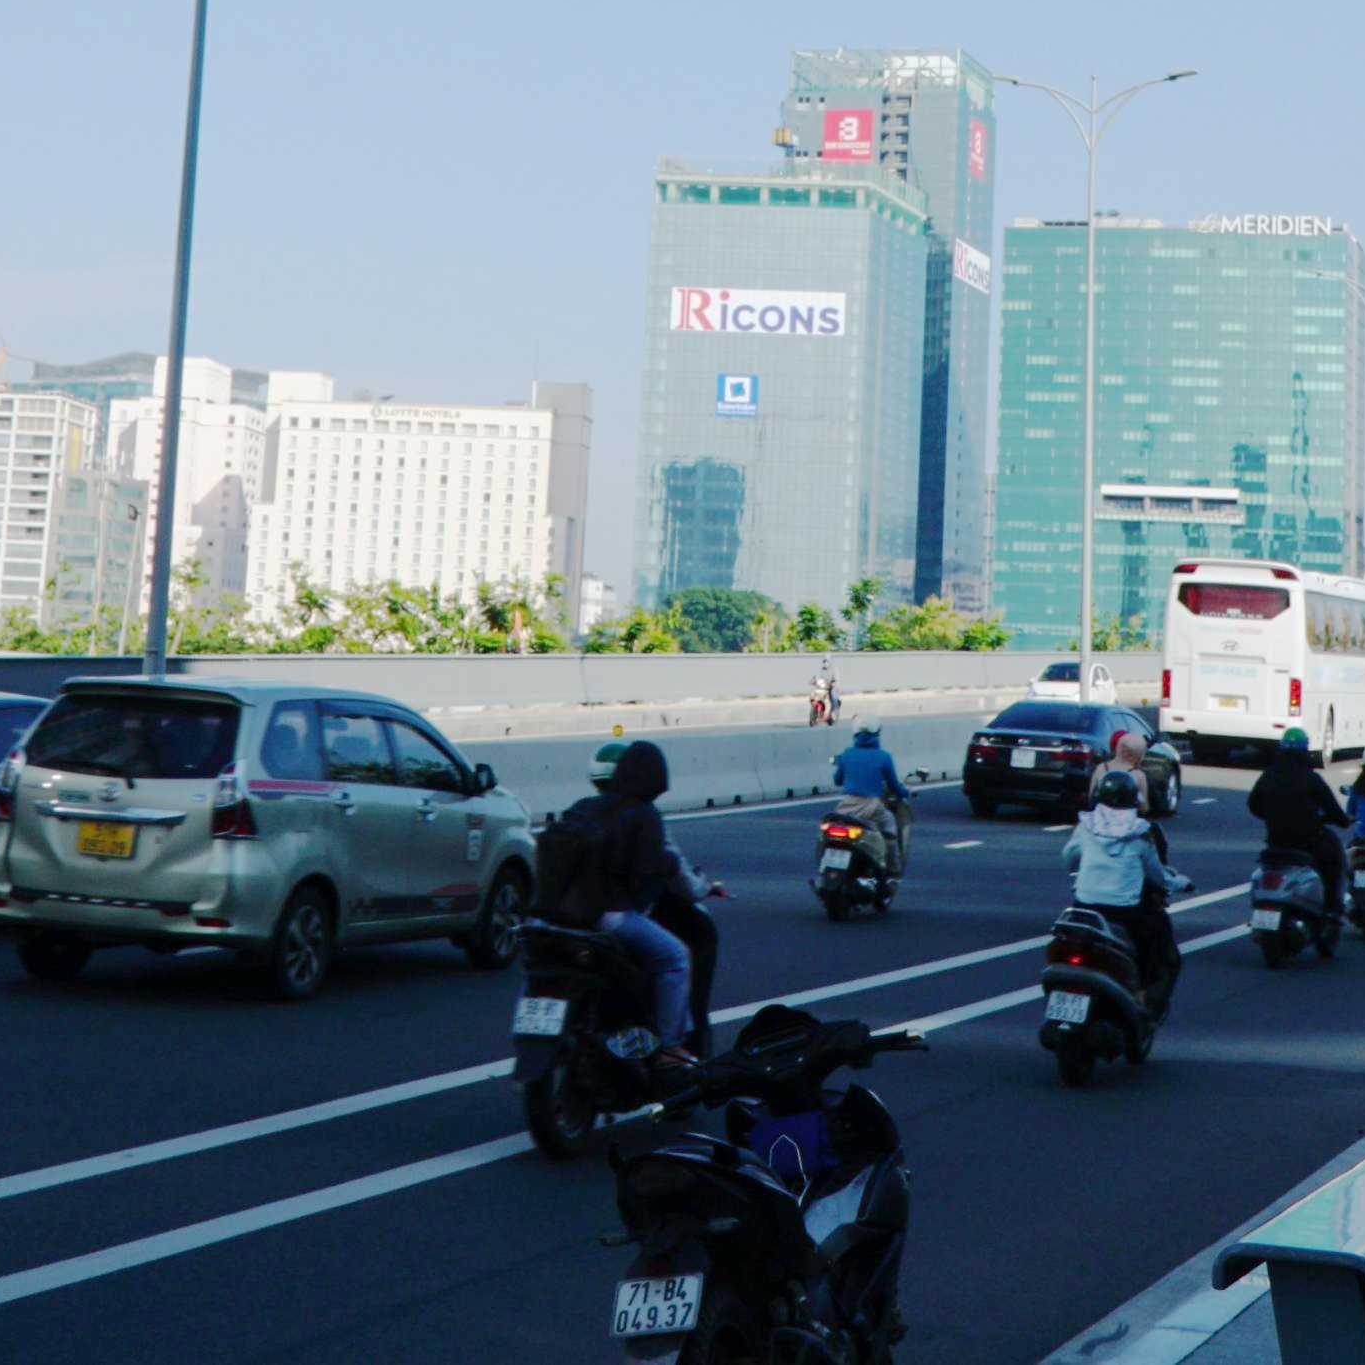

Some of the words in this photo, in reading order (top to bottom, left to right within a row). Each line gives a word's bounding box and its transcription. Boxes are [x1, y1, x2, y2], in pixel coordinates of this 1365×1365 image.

[1221, 213, 1332, 237] MERIDIEN
[384, 407, 420, 418] LOTTE
[422, 409, 461, 419] HOTELS
[628, 1277, 687, 1306] 71-B4
[616, 1302, 693, 1333] 049.37
